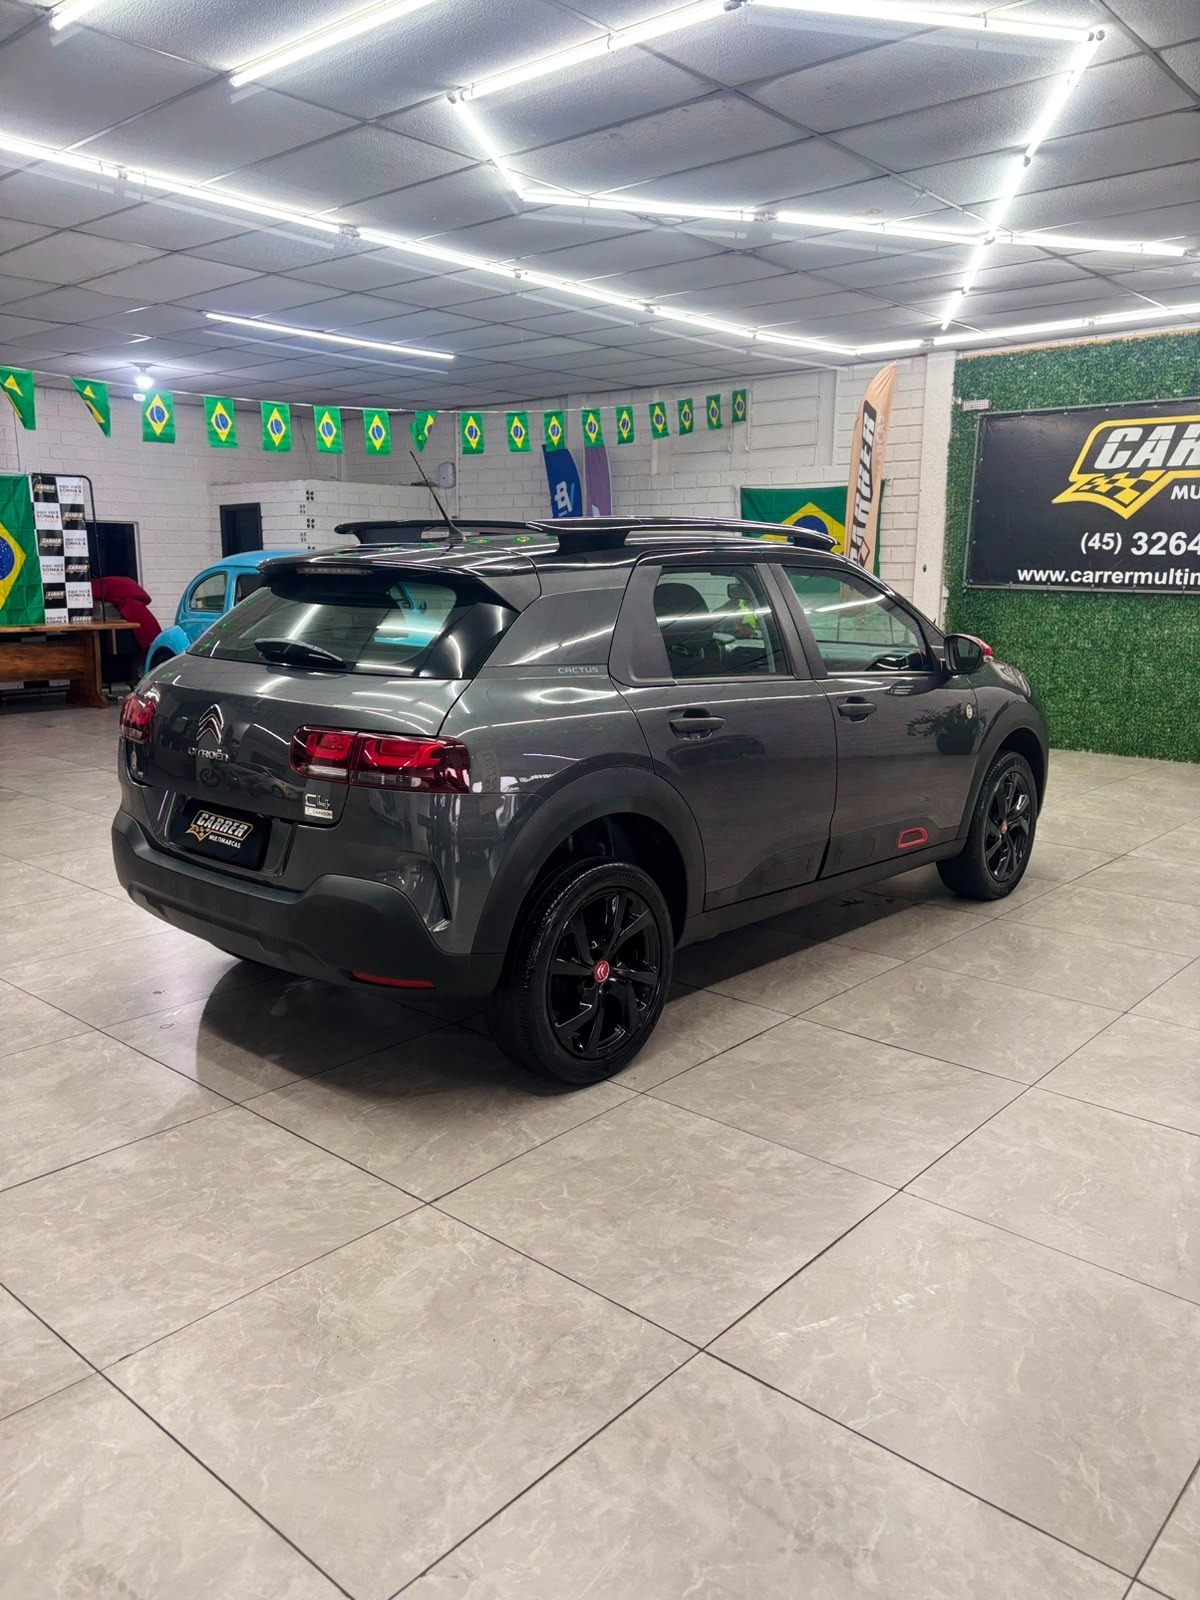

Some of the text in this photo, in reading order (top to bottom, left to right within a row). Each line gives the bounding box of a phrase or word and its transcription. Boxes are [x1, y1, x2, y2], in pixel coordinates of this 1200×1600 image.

[1081, 531, 1200, 556] (45) 3264
[558, 666, 599, 674] CACTUS
[188, 747, 229, 761] CITROËN
[305, 793, 331, 809] C4
[196, 813, 249, 837] CARRER
[208, 834, 241, 849] MULTIMARCAS
